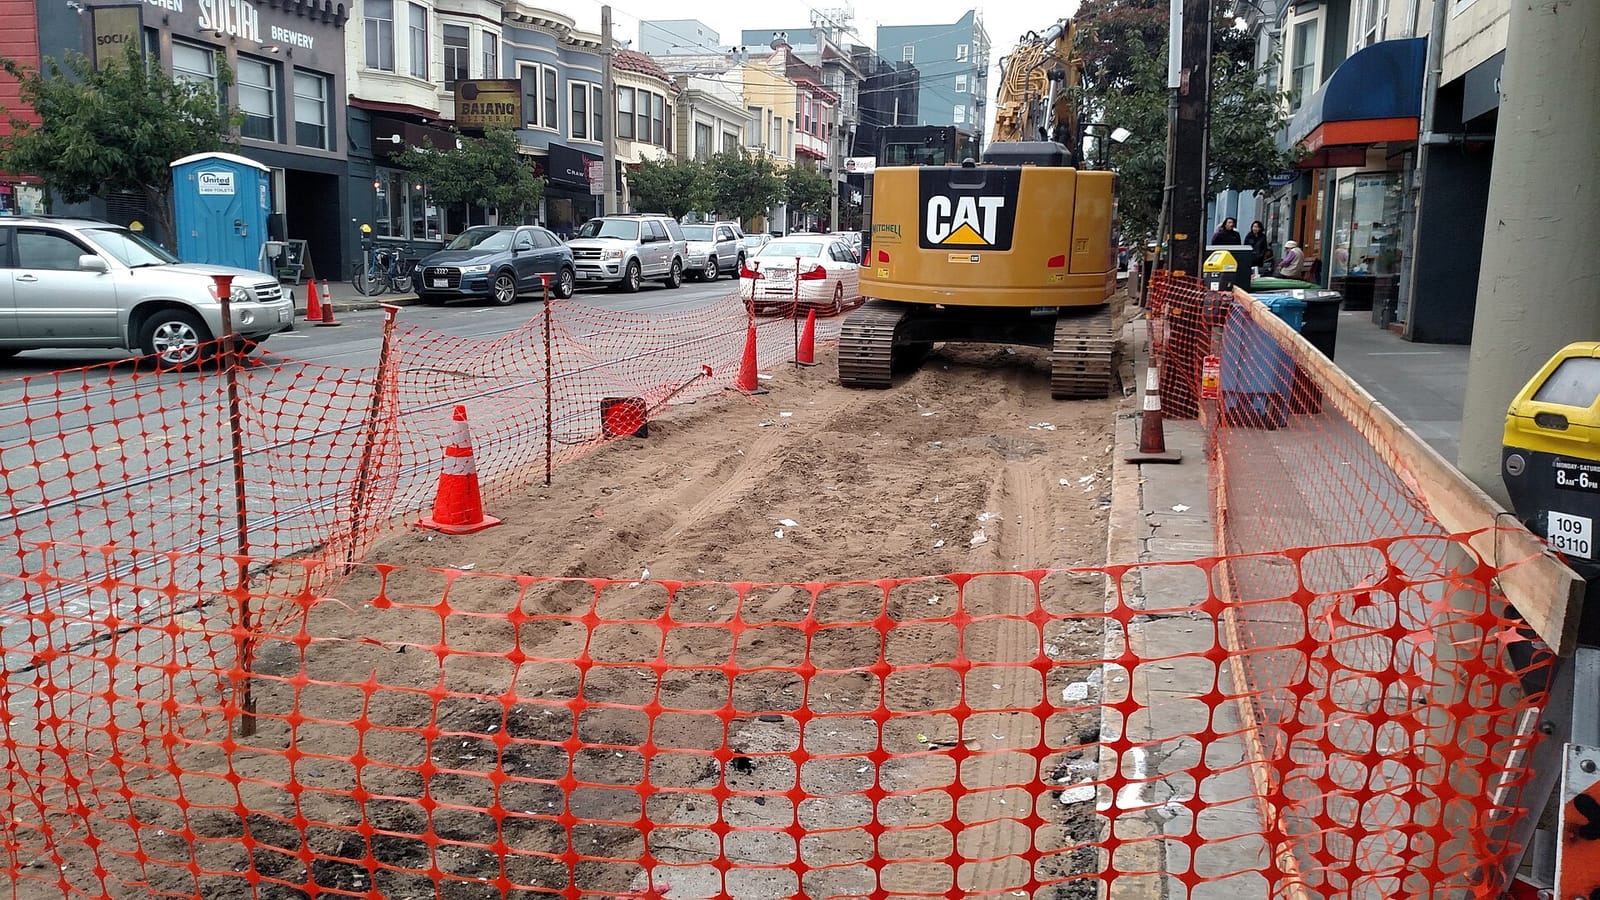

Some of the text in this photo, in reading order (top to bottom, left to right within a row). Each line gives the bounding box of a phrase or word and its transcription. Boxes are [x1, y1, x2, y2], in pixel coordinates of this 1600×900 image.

[198, 0, 263, 43] SOCIAL
[271, 25, 314, 49] BREWERY
[462, 102, 514, 115] BAIANO
[203, 176, 230, 184] United
[926, 195, 1005, 245] CAT
[1557, 518, 1582, 534] 109
[1550, 534, 1588, 554] 13110
